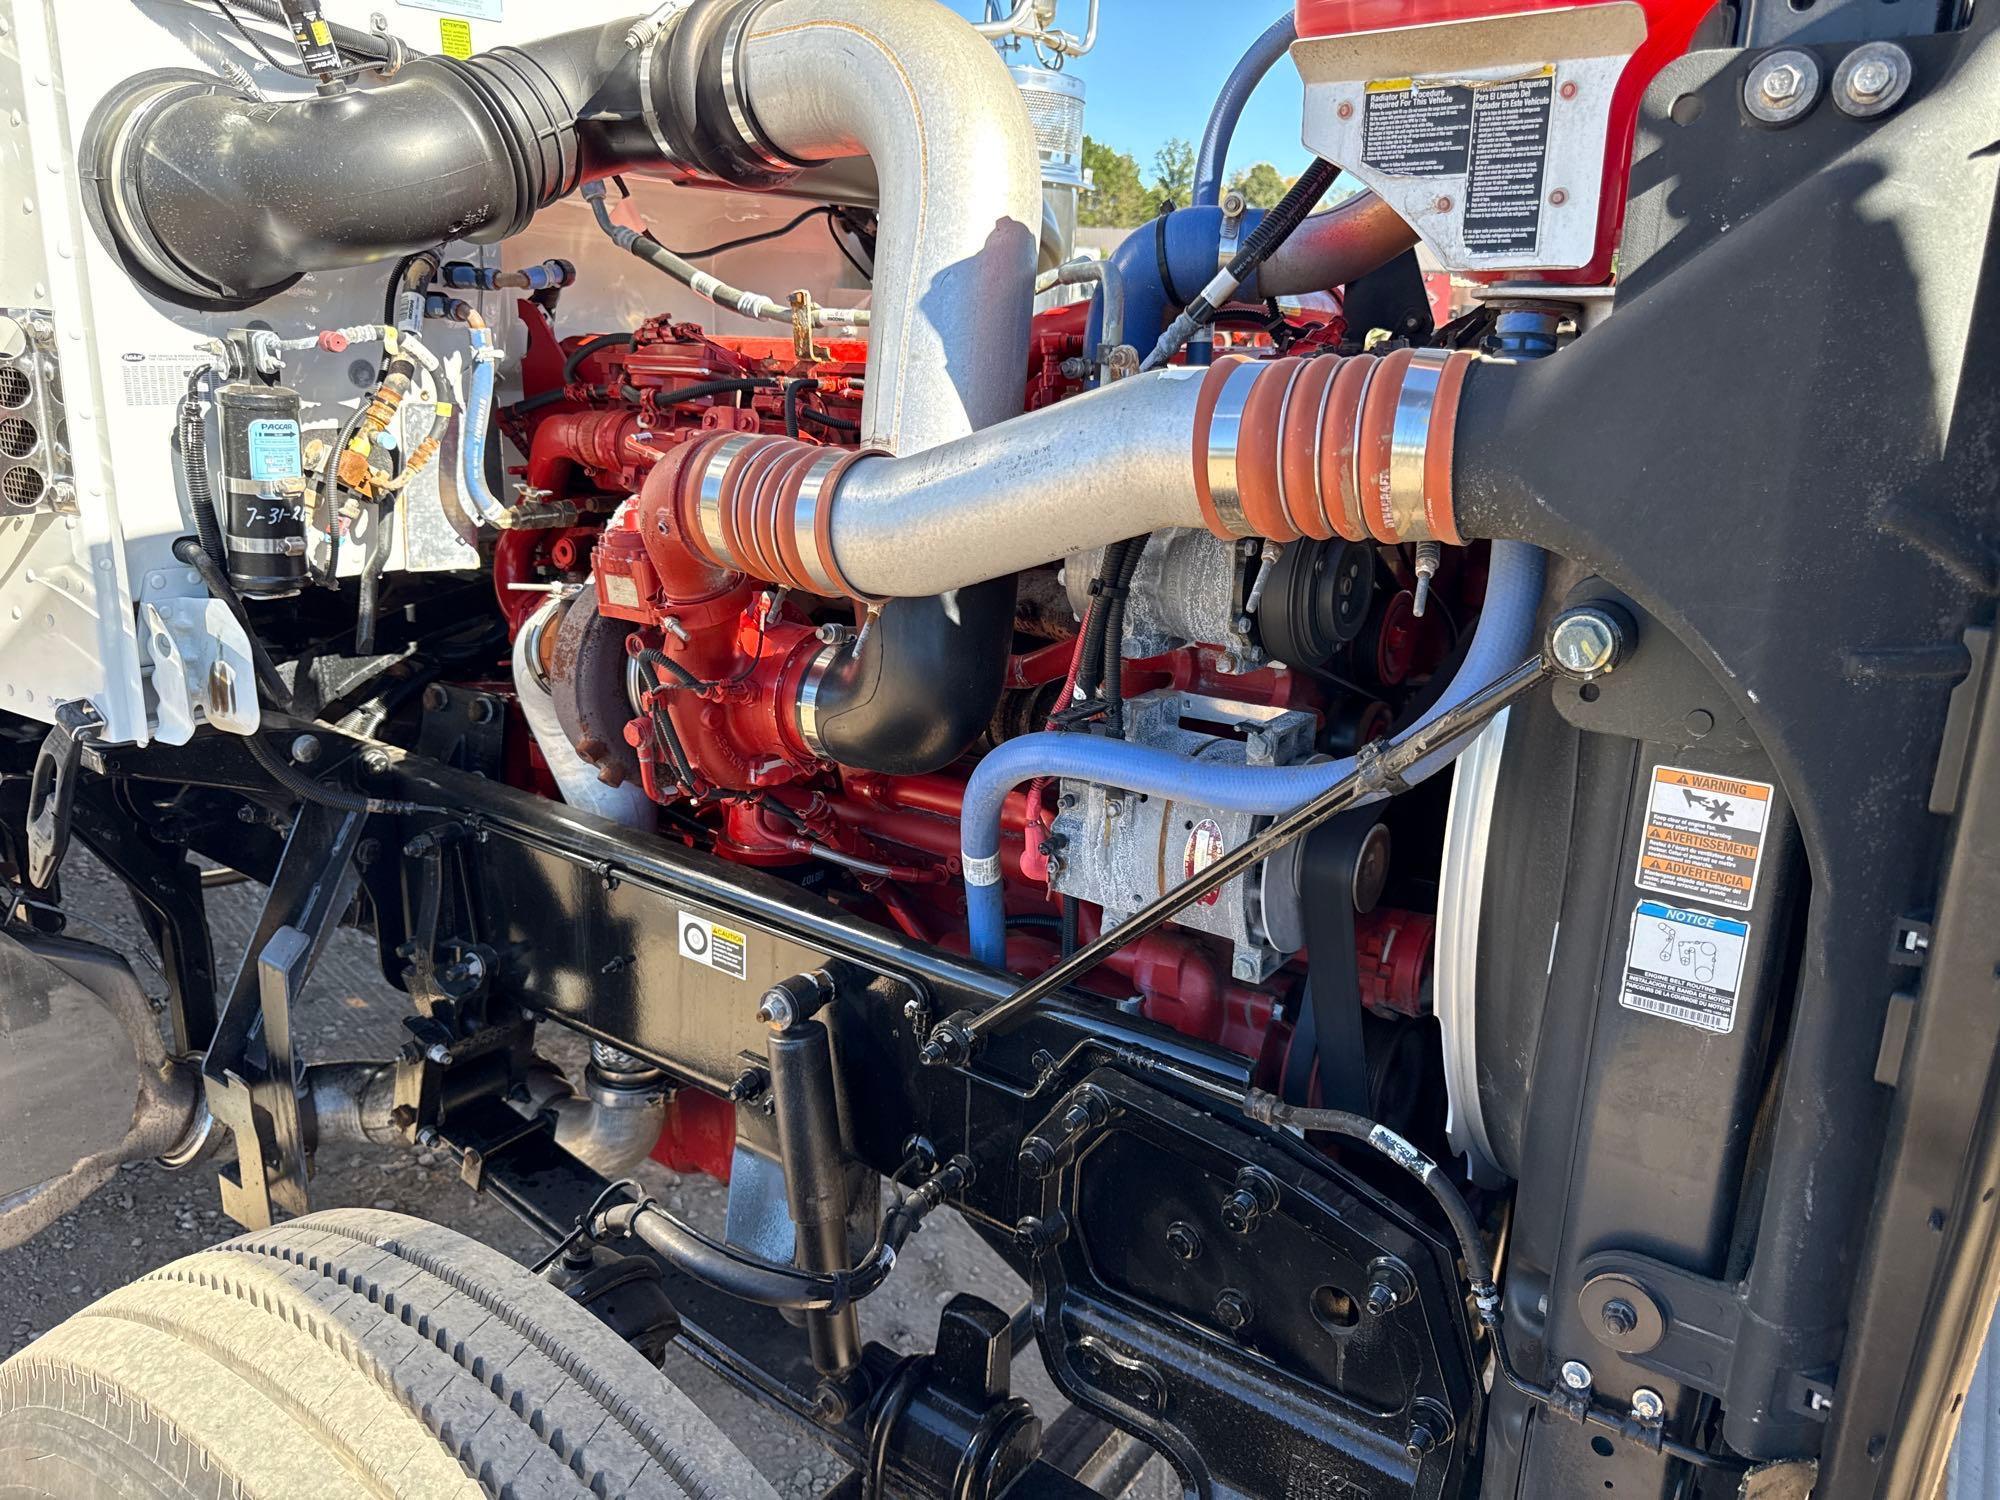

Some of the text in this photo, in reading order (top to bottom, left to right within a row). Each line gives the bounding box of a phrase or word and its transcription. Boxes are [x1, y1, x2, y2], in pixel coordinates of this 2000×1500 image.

[1370, 100, 1399, 110] Required
[1413, 97, 1427, 106] This
[1429, 95, 1453, 104] Vehicle
[1371, 94, 1398, 102] Radiator
[1476, 102, 1500, 110] Radiador
[1524, 97, 1549, 106] Vehículo
[1497, 91, 1519, 100] Llenado
[1521, 89, 1531, 97] Del
[1692, 775, 1747, 795] WARNING
[1664, 830, 1756, 856] AVERTISSEMENT
[1665, 861, 1744, 887] ADVERTENCIA
[1665, 908, 1716, 928] NOTICE
[717, 929, 743, 944] CAUTION
[1628, 975, 1666, 988] INSTALACION
[1676, 986, 1697, 996] BANDA
[1707, 994, 1730, 1004] MOTOR
[1644, 971, 1716, 993] ENGINE BELT ROUTING
[1625, 982, 1654, 993] PARCOURS
[1707, 1001, 1731, 1012] MOTEUR
